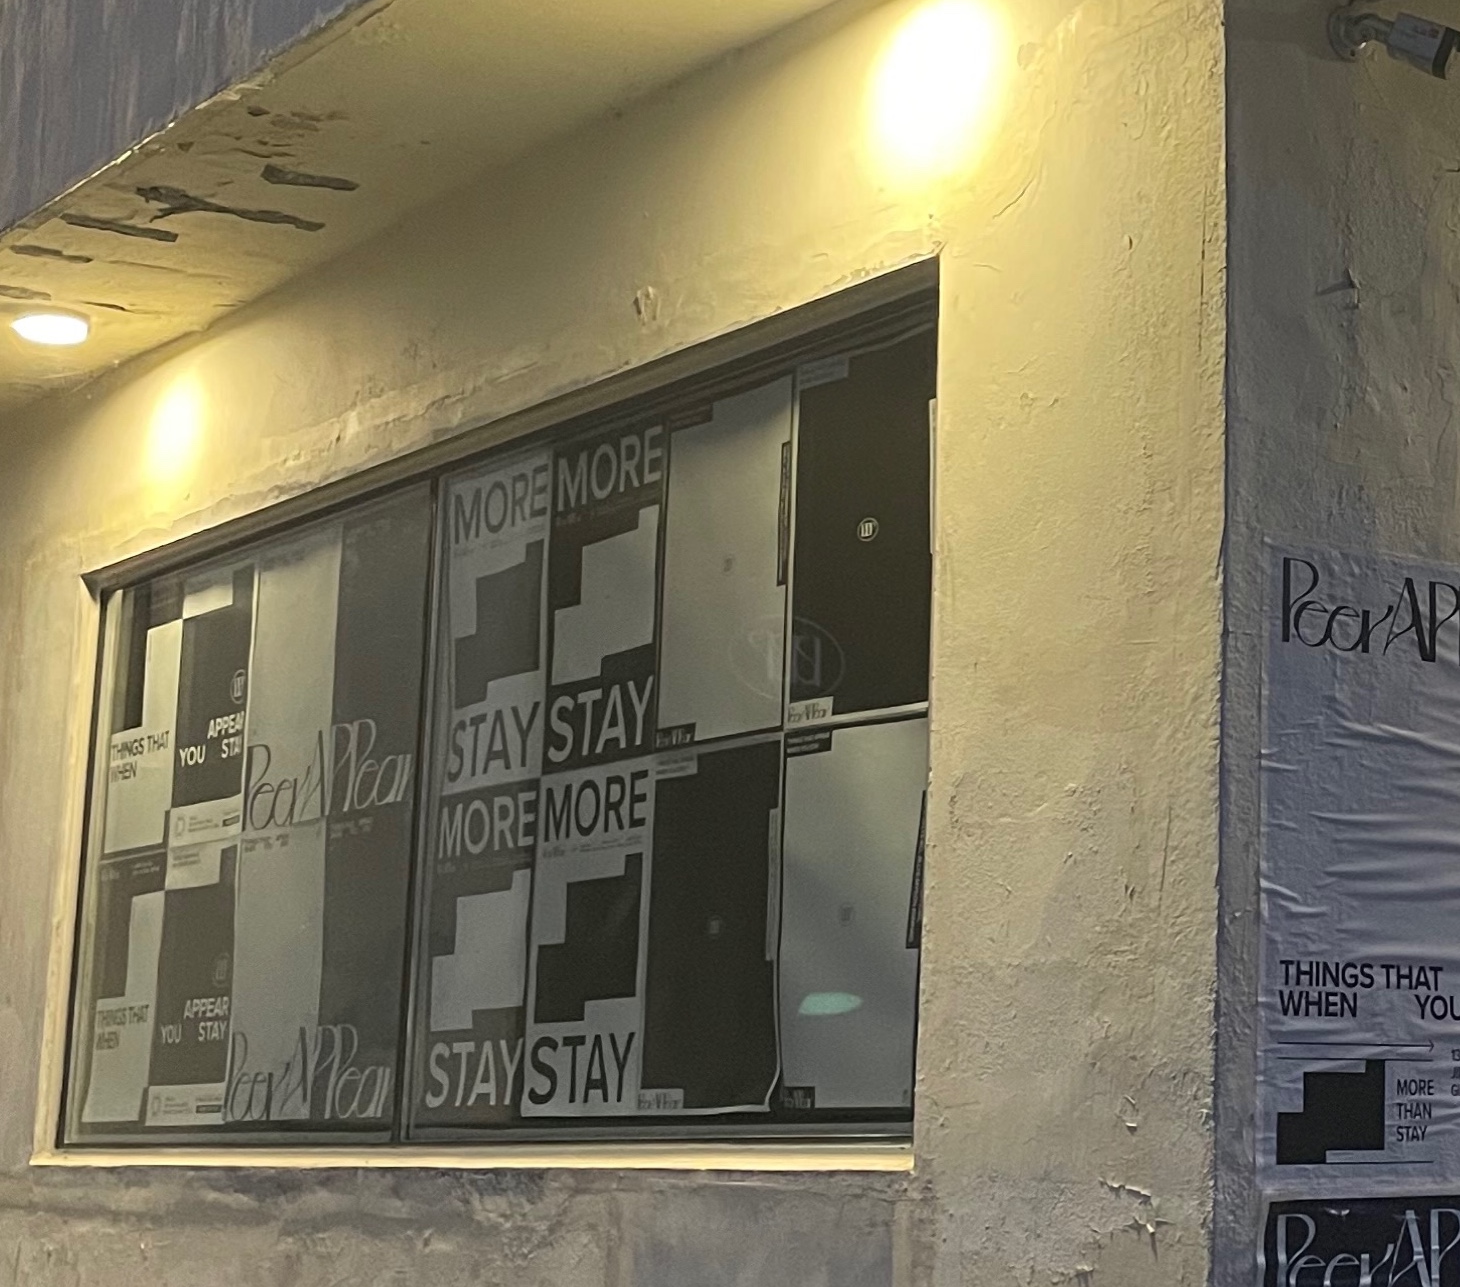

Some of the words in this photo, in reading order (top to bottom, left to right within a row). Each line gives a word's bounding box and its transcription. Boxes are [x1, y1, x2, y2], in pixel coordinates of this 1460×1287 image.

[453, 462, 549, 545] MORE
[558, 425, 663, 512] MORE
[147, 730, 169, 753] THAT
[207, 711, 245, 739] APPEA
[448, 700, 541, 783] STAY
[548, 675, 653, 762] STAY
[179, 744, 206, 768] YOU
[221, 735, 243, 759] STA
[438, 790, 537, 860] MORE
[544, 769, 649, 843] MORE
[1280, 960, 1374, 989] THINGS
[1381, 964, 1443, 992] THAT
[184, 996, 231, 1020] APPEAR
[1280, 990, 1358, 1018] WHEN
[160, 1024, 183, 1045] YOU
[198, 1021, 228, 1043] STAY
[425, 1037, 524, 1109] STAY
[528, 1031, 636, 1105] STAY
[1396, 1079, 1434, 1097] MORE
[1396, 1102, 1432, 1120] THAN
[1396, 1125, 1428, 1143] STAY
